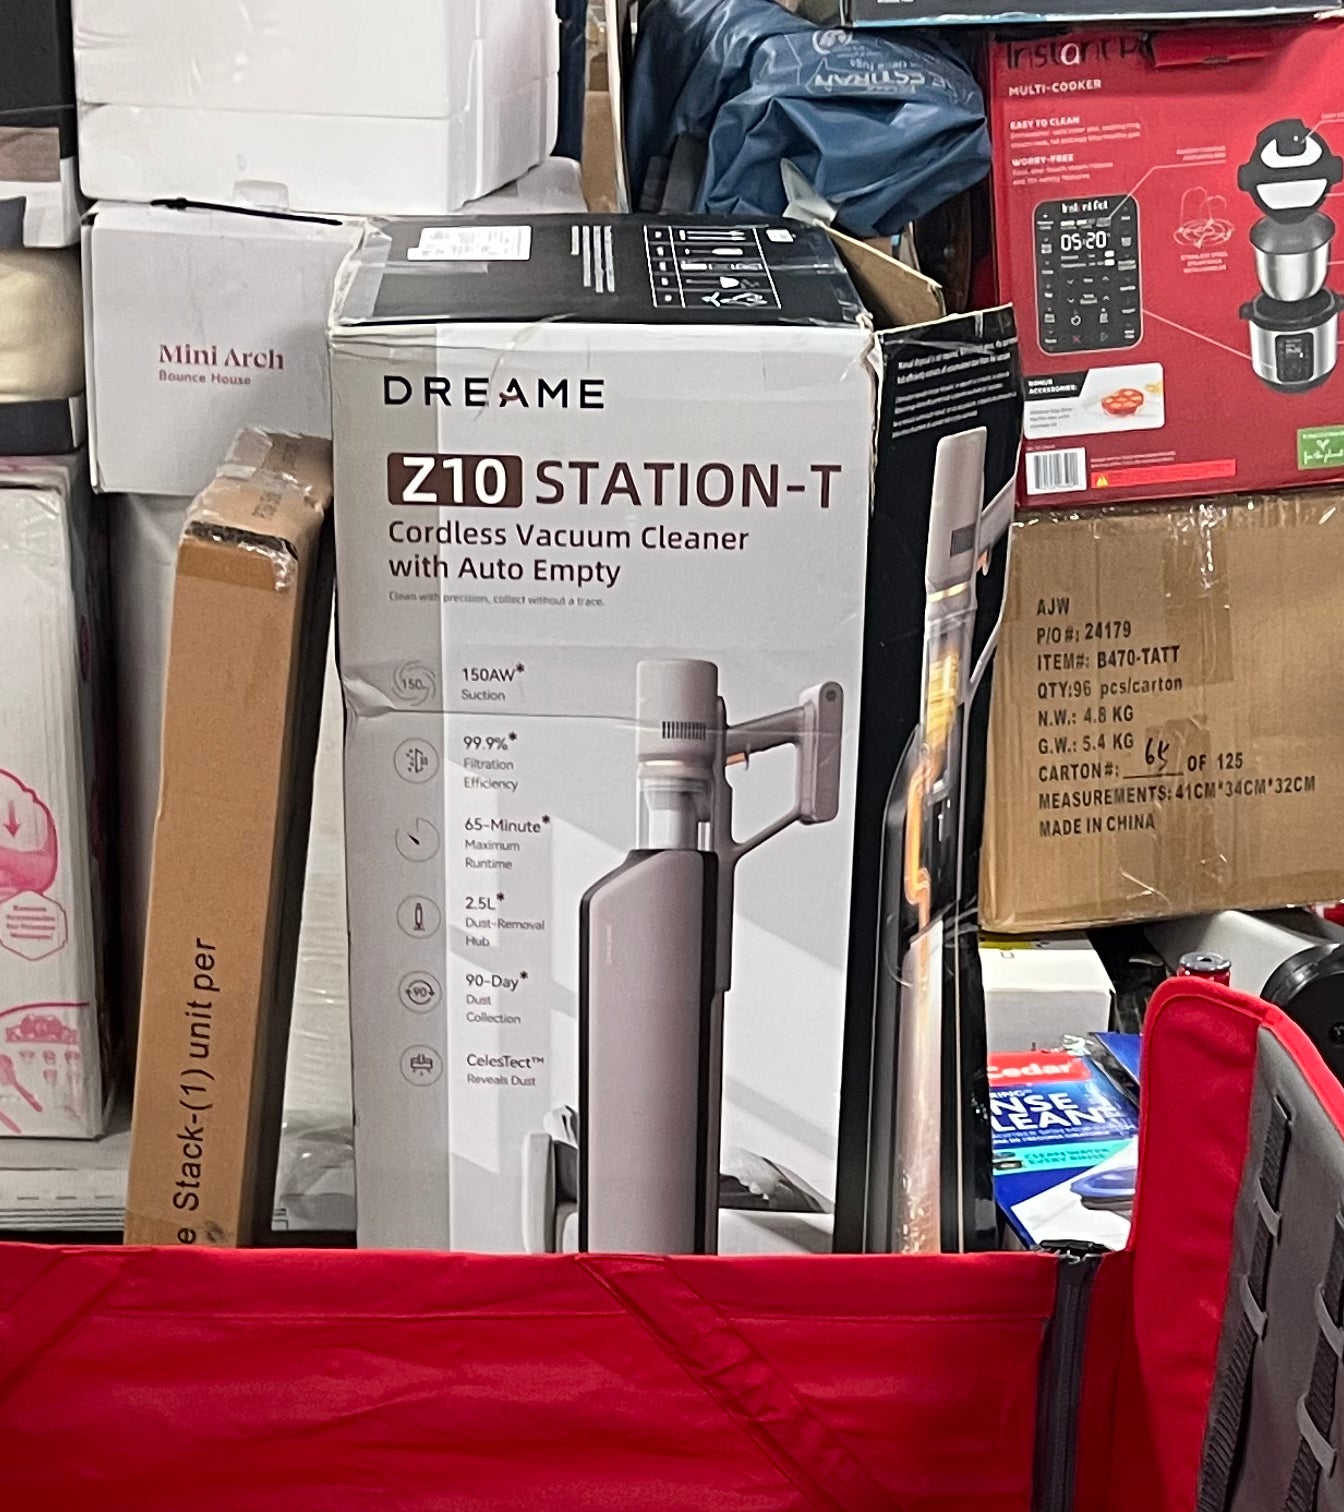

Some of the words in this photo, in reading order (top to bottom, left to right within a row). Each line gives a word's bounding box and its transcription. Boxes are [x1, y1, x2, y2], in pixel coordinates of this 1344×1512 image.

[1009, 79, 1102, 96] MULTI-COOKER
[1049, 116, 1080, 127] CLEAN
[158, 343, 217, 366] Mini
[224, 345, 285, 370] Arch
[158, 369, 207, 384] Bounce
[211, 372, 252, 386] House
[384, 376, 604, 409] DREAME
[402, 456, 508, 505] Z10
[535, 460, 842, 509] STATION-T
[388, 520, 507, 547] Cordless
[516, 523, 632, 549] Vacuum
[641, 525, 750, 551] Cleaner
[388, 553, 449, 580] with
[459, 557, 524, 582] Auto
[534, 558, 621, 589] Empty
[389, 591, 417, 601] Clean
[419, 592, 439, 601] with
[443, 592, 491, 605] precision,
[493, 594, 526, 605] collect
[528, 596, 565, 606] without
[1036, 598, 1071, 616] AJW
[1084, 621, 1132, 641] 24179
[1037, 653, 1090, 671] ITEM#:
[1096, 646, 1181, 670] B470-TATT
[461, 689, 506, 702] Suction
[1099, 676, 1183, 699] pcs/carton
[1037, 708, 1079, 728] N.W.:
[1083, 707, 1108, 725] 4.8
[1112, 705, 1134, 723] KG
[1038, 736, 1079, 756] G.W.:
[1083, 735, 1107, 753] 5.4
[1113, 733, 1135, 751] KG
[463, 758, 514, 771] Filtration
[1187, 755, 1207, 773] OF
[1217, 753, 1244, 770] 125
[464, 777, 519, 792] Efficiency
[1039, 819, 1083, 838] MADE
[1085, 817, 1103, 834] IN
[1106, 814, 1156, 832] CHINA
[465, 839, 520, 852] Maximum
[465, 858, 512, 871] Runtime
[465, 917, 545, 931] Dust-Removal
[465, 935, 490, 948] Hub
[194, 937, 221, 993] per
[413, 986, 427, 998] 90
[466, 993, 492, 1006] Dust
[466, 1012, 522, 1026] Collection
[185, 999, 214, 1060] unit
[467, 1073, 509, 1086] Reveals
[512, 1074, 537, 1087] Dust
[990, 1092, 1078, 1116] NSE
[991, 1107, 1106, 1132] LEAN
[172, 1068, 215, 1212] Stack-(1)
